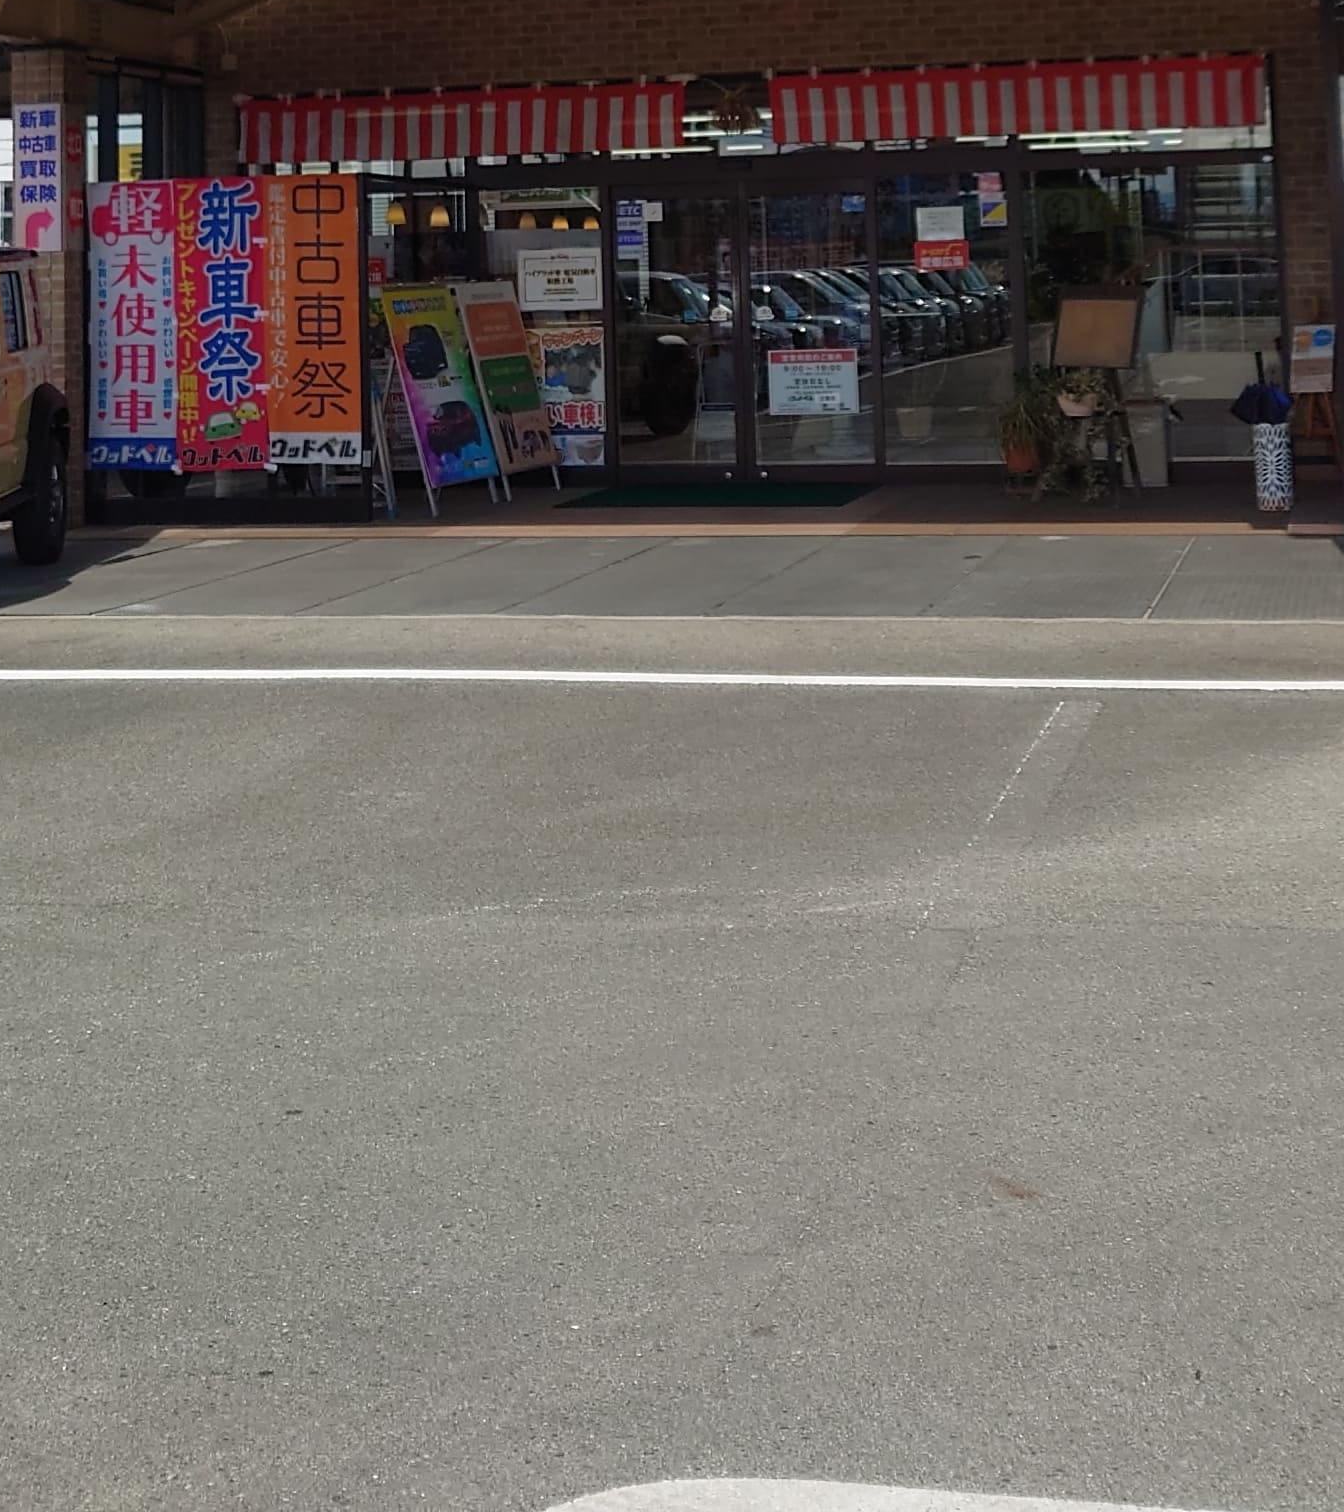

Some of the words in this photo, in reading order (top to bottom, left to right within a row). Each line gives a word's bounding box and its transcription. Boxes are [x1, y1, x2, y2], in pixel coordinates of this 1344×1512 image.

[20, 110, 56, 128] 新車
[19, 136, 56, 154] 中古車
[20, 160, 56, 178] 買取
[20, 185, 57, 204] 保険
[197, 181, 260, 404] 新車祭
[291, 178, 352, 419] 中古車祭
[110, 185, 164, 434] 軽未使用車
[181, 447, 264, 468] ウッドベル
[270, 439, 357, 460] ウッドベル
